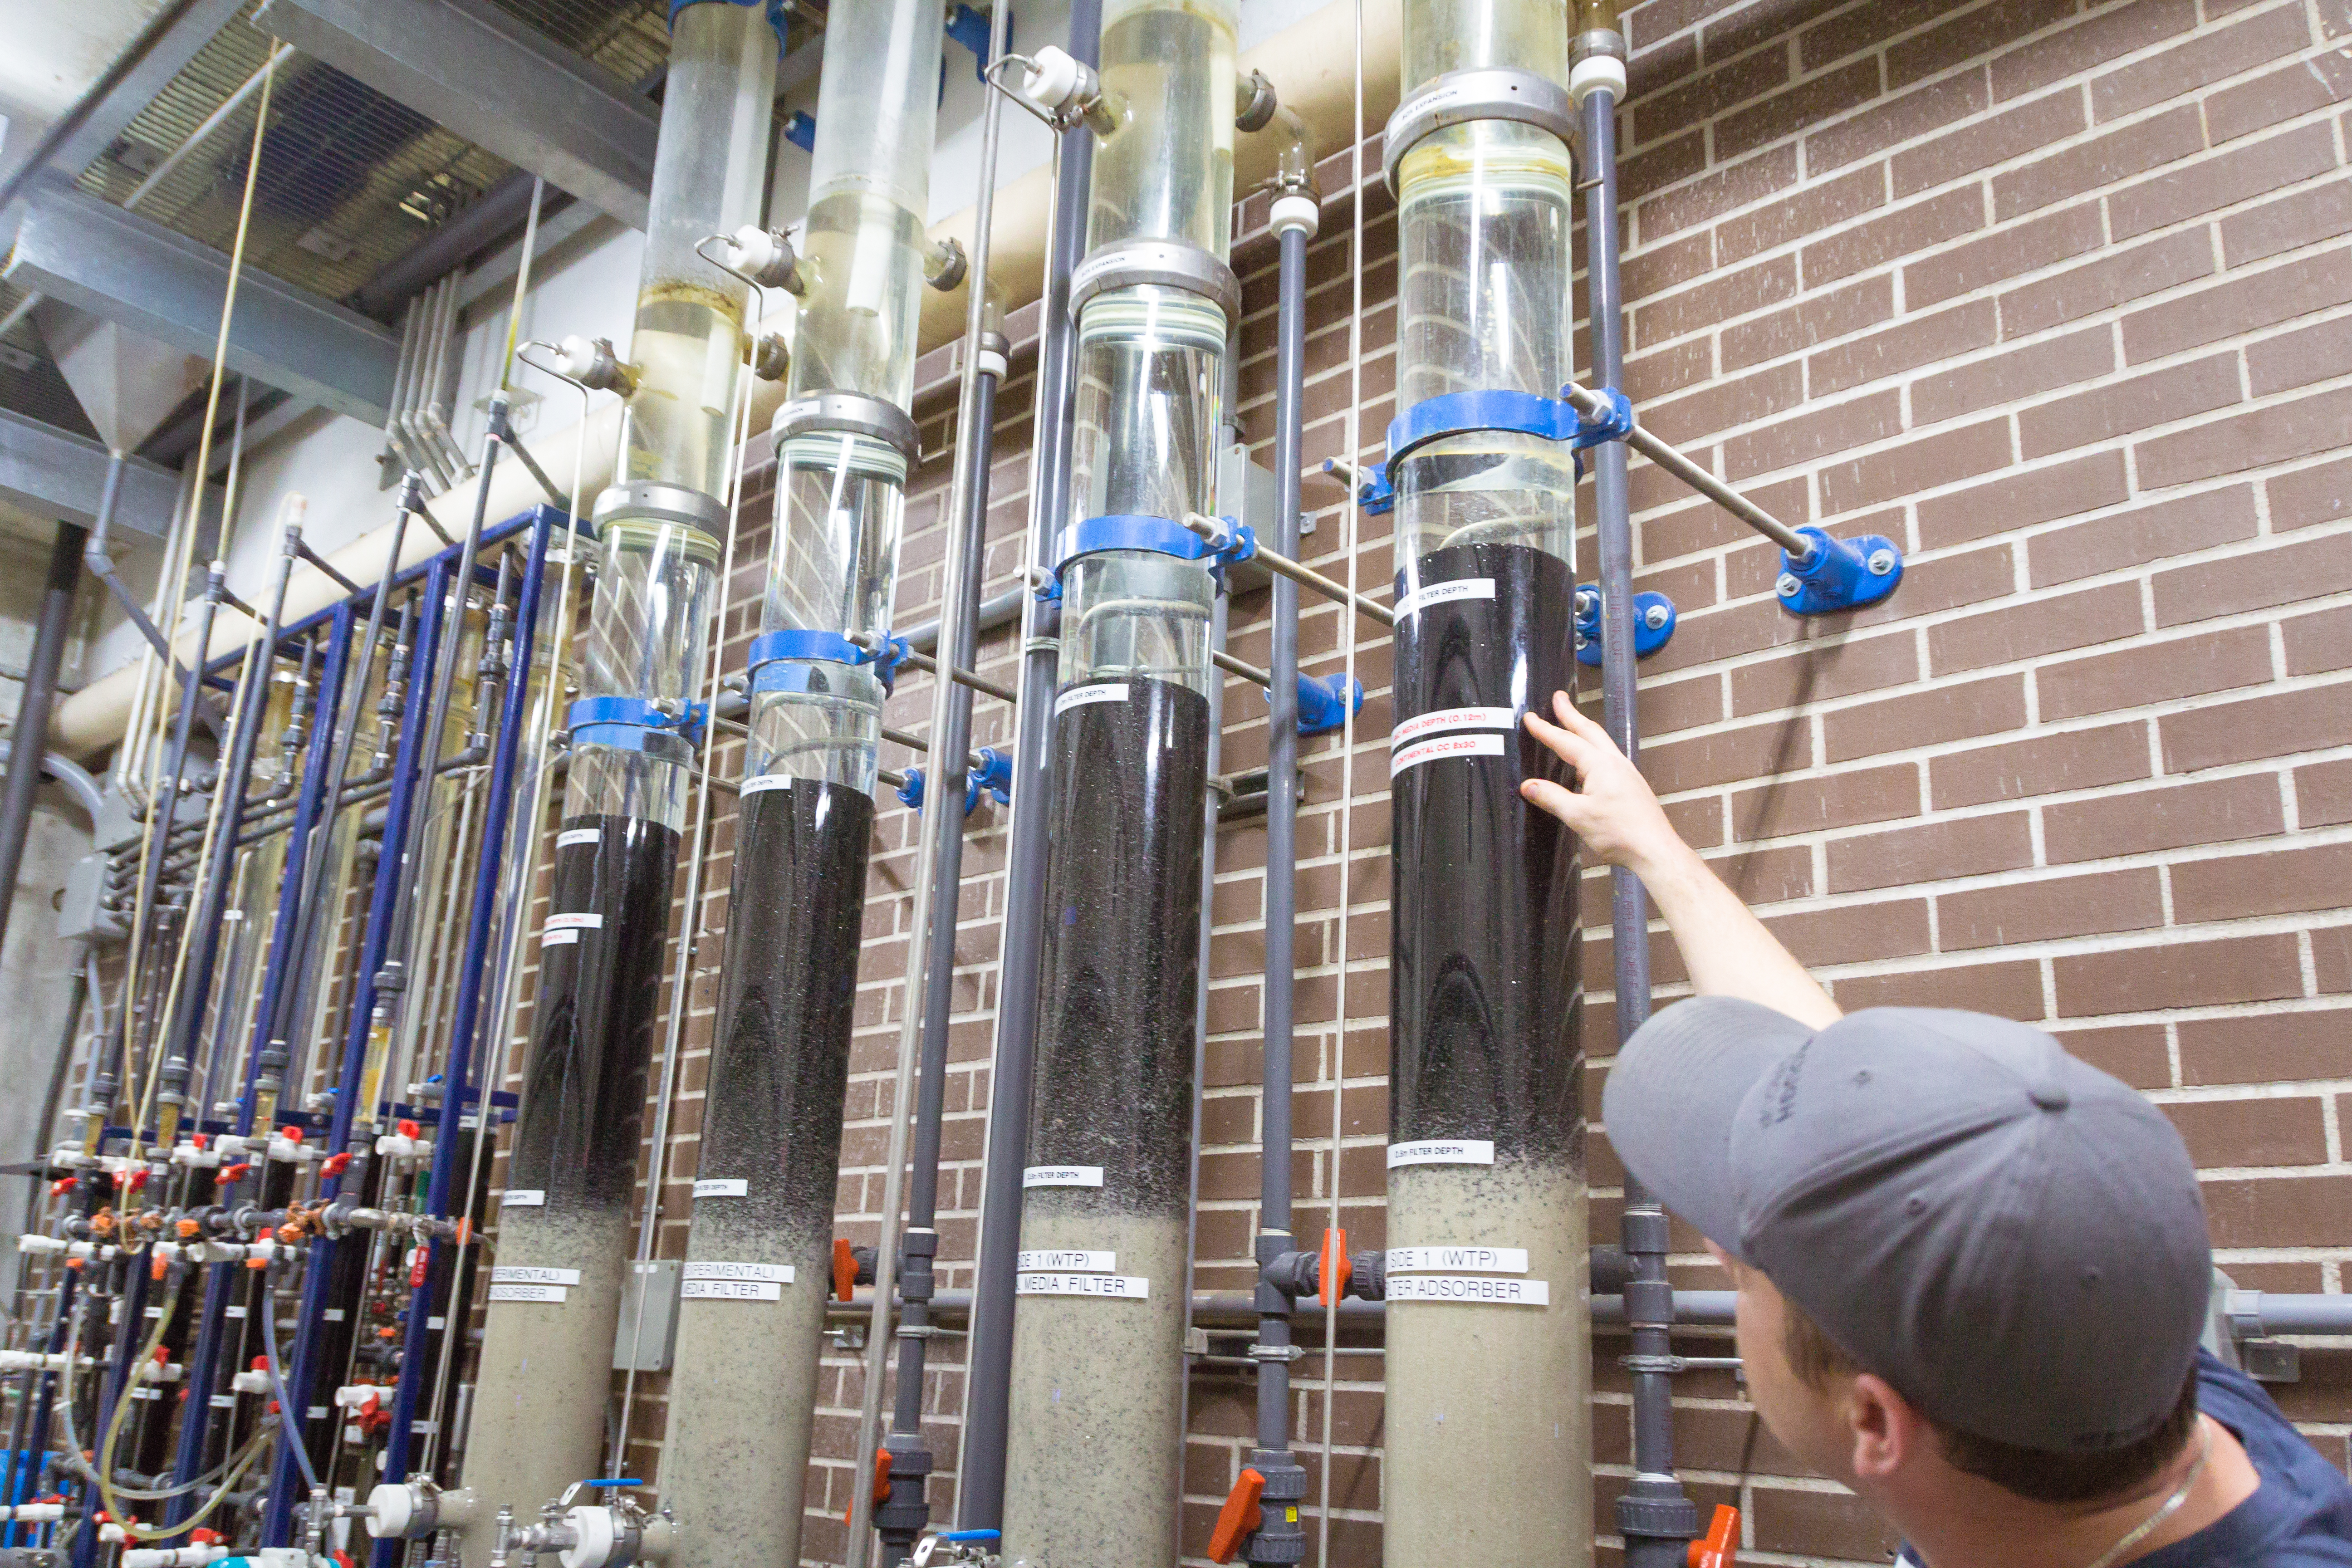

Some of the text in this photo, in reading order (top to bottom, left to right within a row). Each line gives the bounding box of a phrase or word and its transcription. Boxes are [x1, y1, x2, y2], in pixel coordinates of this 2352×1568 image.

[1415, 89, 1458, 111] EXPANSION
[1442, 585, 1469, 595] DEPTH
[1421, 717, 1446, 728] DEPTH
[1436, 743, 1450, 751] CC
[1409, 1147, 1432, 1156] FILTER
[1435, 1147, 1464, 1155] DEPTH
[1038, 1254, 1042, 1267] 1
[1047, 1253, 1090, 1268] (WTP)
[1391, 1250, 1498, 1268] SIDE 1 (WTP)
[713, 1283, 759, 1296] FILTER
[1024, 1276, 1060, 1291] MEDIA
[1068, 1277, 1126, 1293] FILTER
[1416, 1279, 1522, 1299] ADSORBER
